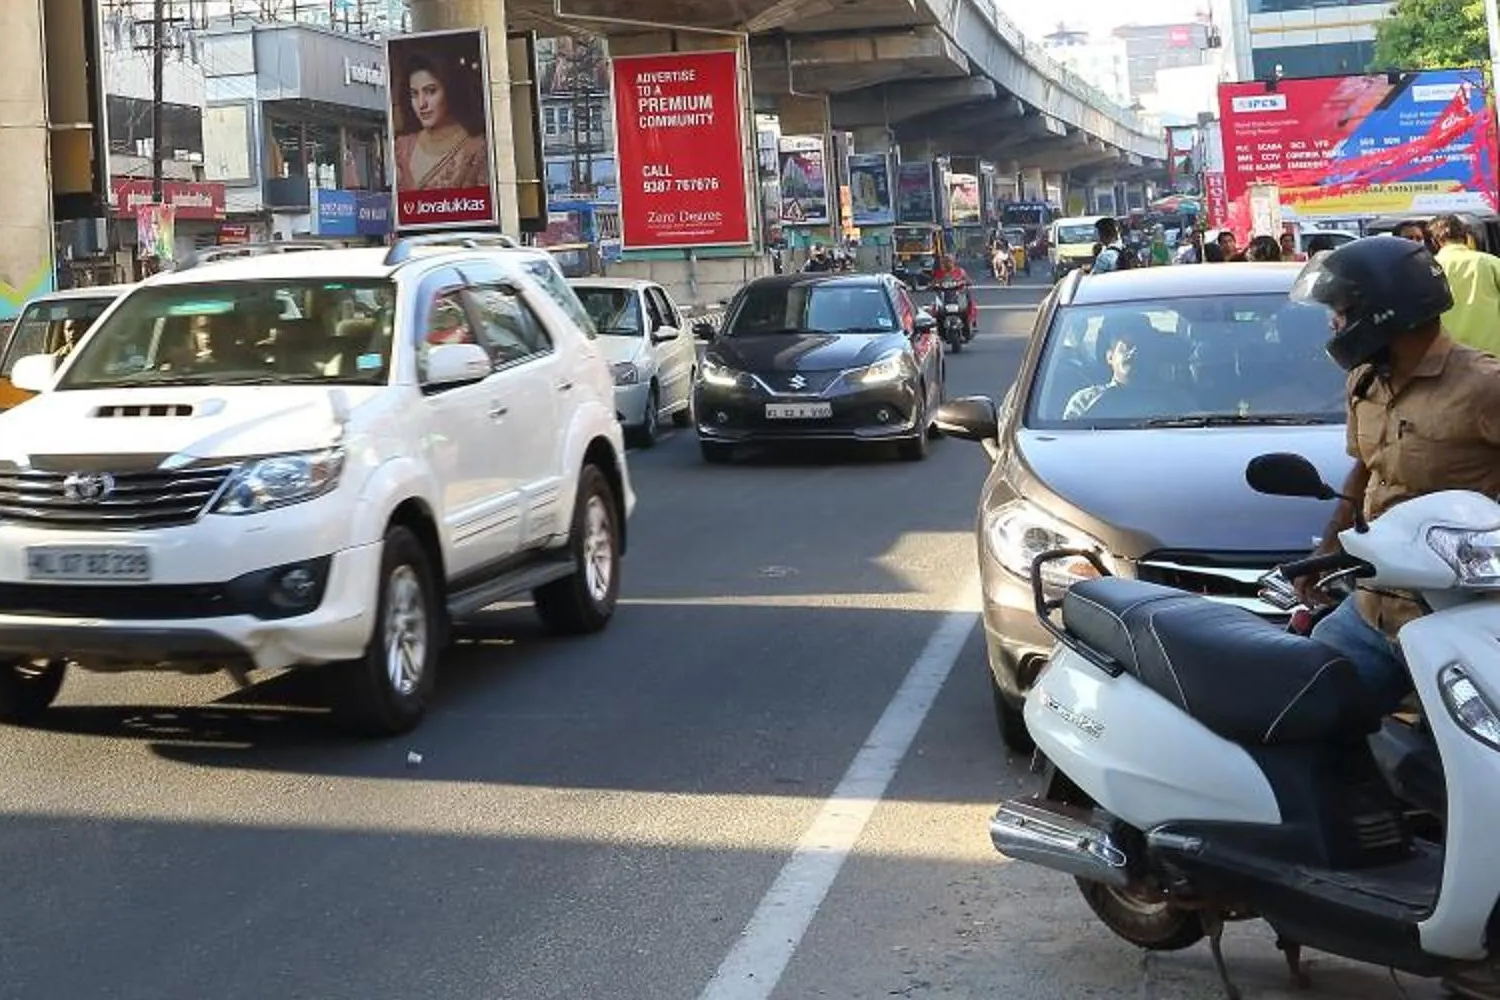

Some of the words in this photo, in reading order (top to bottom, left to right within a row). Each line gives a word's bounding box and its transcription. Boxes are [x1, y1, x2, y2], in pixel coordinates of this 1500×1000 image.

[636, 69, 696, 84] ADVERTISE
[637, 85, 651, 97] TO
[654, 85, 662, 96] A
[638, 94, 713, 113] PREMIUM
[639, 112, 715, 129] COMMUNITY
[643, 165, 673, 178] CALL
[643, 182, 672, 193] 9387
[647, 211, 675, 223] Zero
